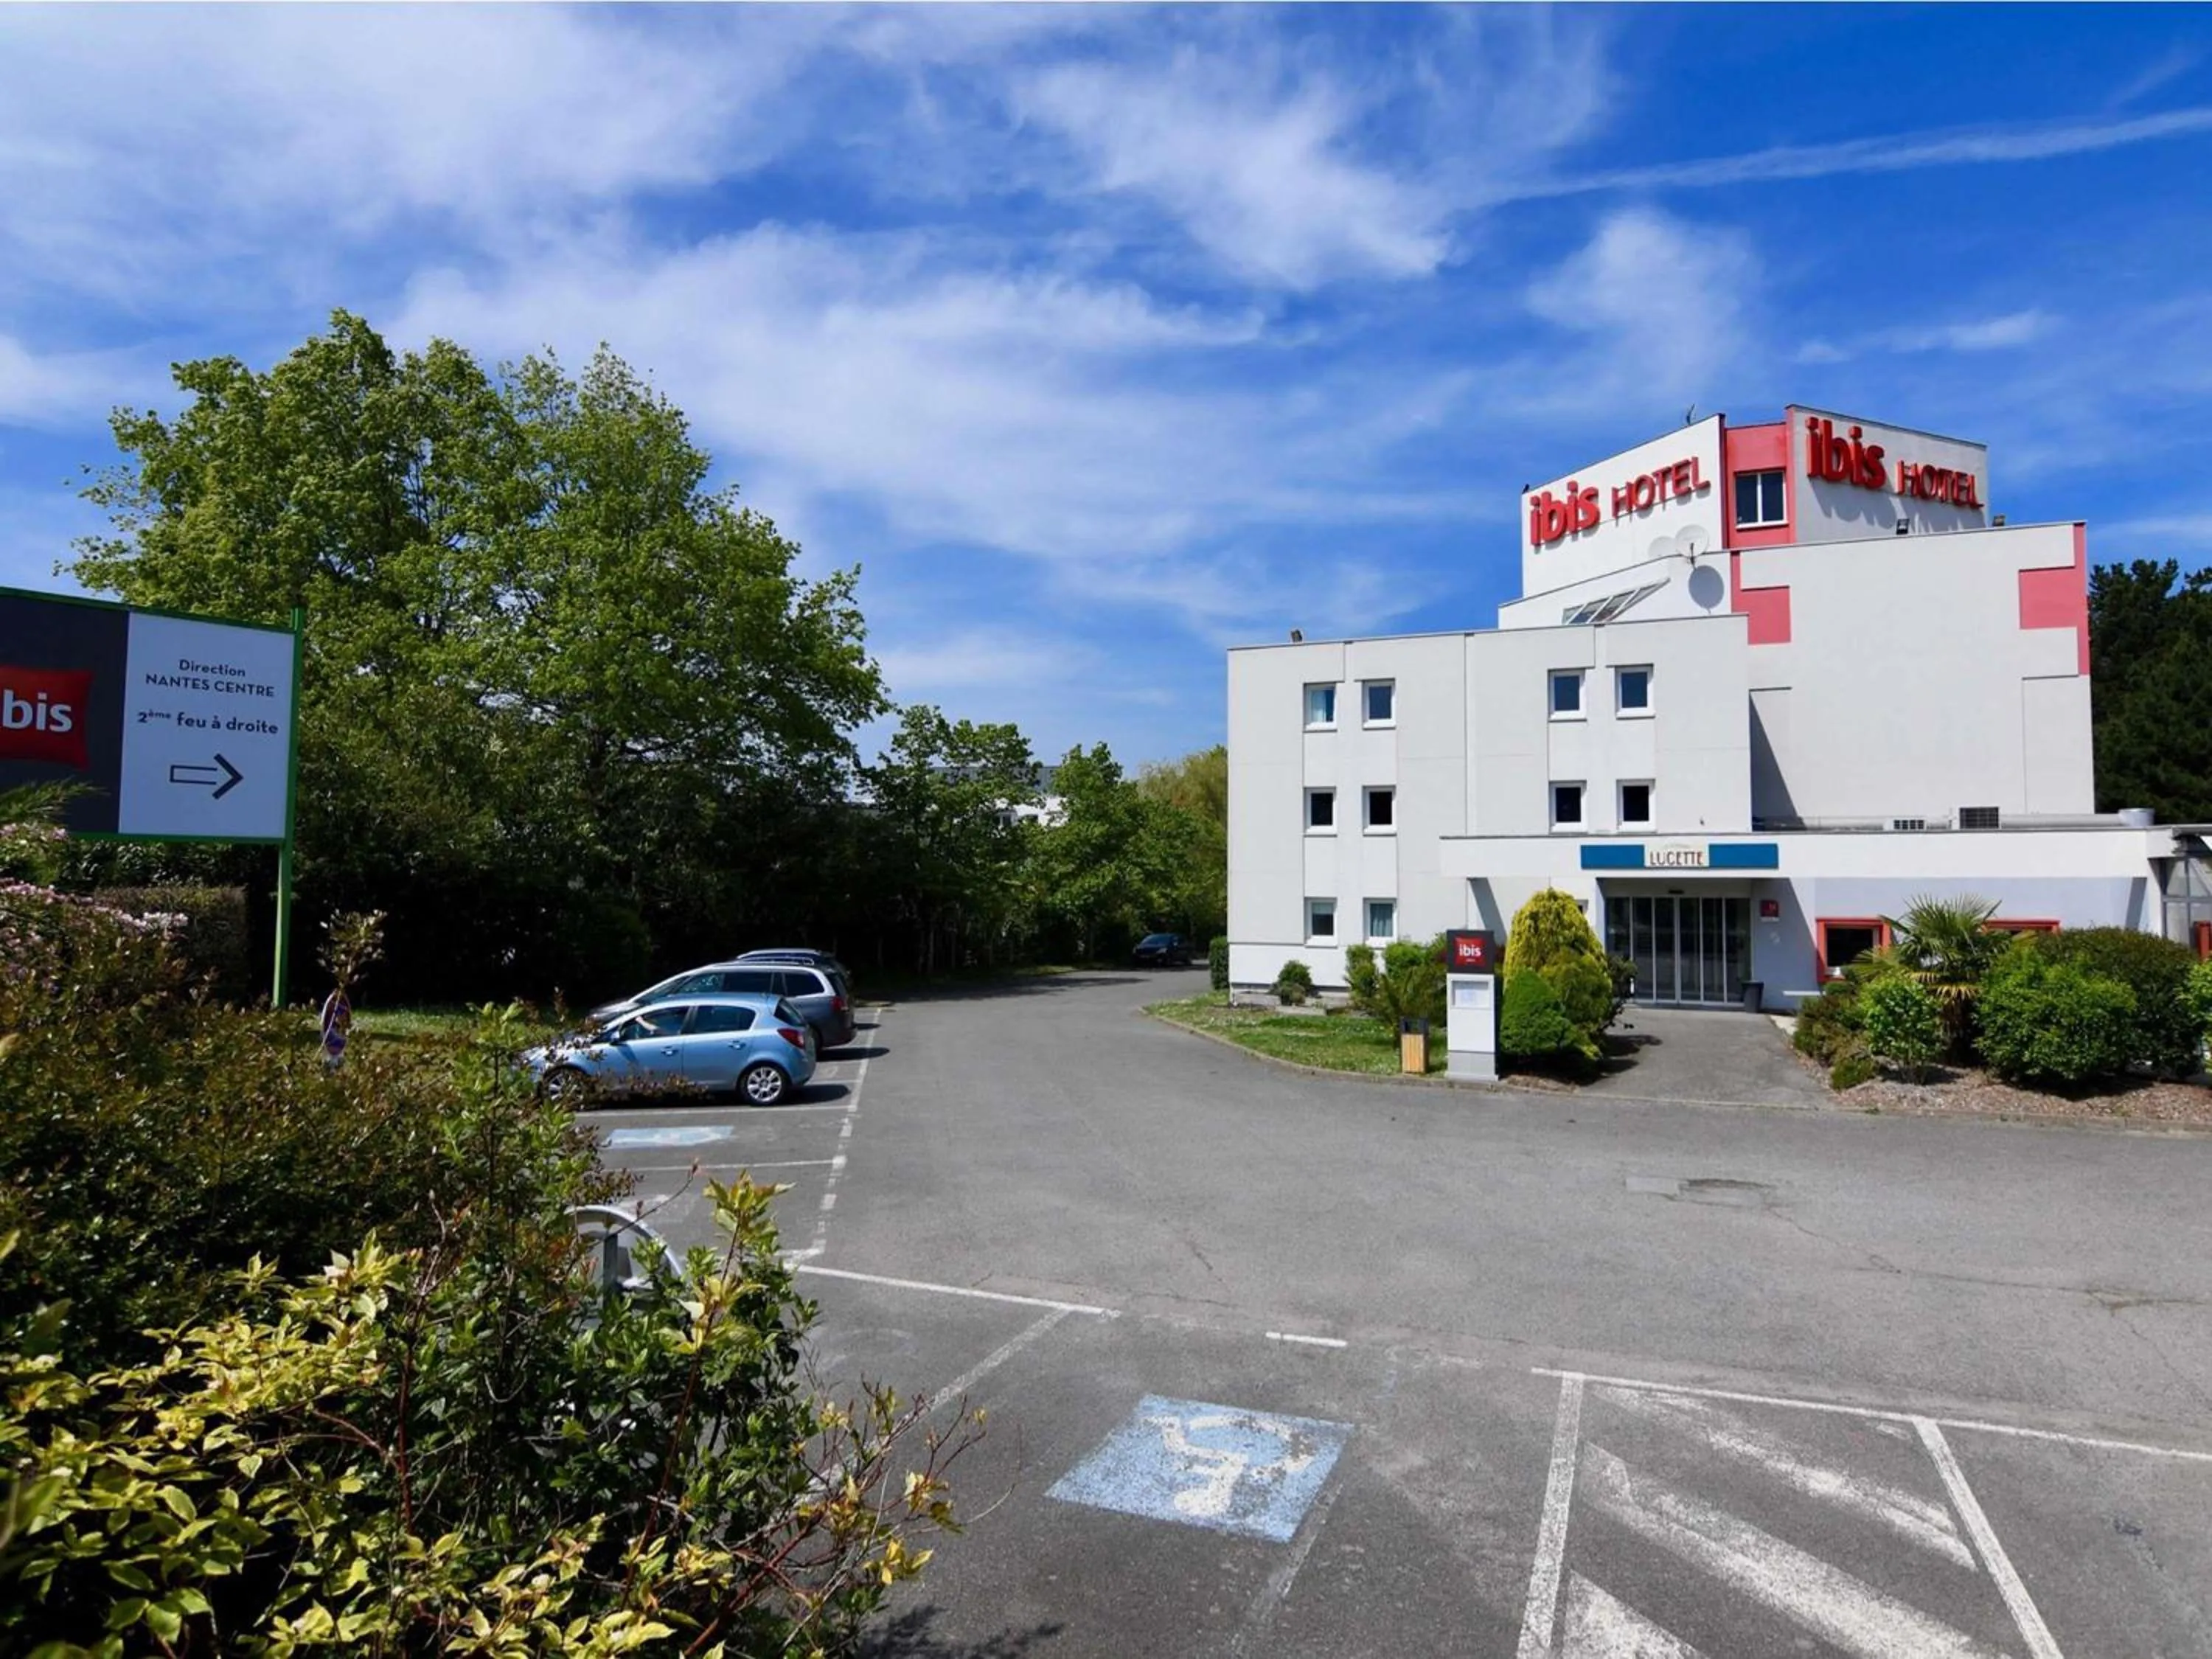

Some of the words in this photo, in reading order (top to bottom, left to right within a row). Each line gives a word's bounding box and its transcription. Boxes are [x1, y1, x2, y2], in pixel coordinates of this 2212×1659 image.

[1806, 417, 1886, 490] ibis
[1896, 460, 1983, 509] HOTEL
[1530, 481, 1599, 546] ibis
[1612, 456, 1711, 519] HOTEL
[179, 659, 246, 677] Direction
[146, 674, 210, 691] NANTES
[215, 681, 274, 697] CENTRE
[2, 689, 72, 732] bis
[138, 709, 172, 723] 2ème
[177, 712, 206, 728] feu
[212, 715, 220, 729] à
[226, 717, 279, 734] droite
[1650, 851, 1703, 865] LUCETTE
[1459, 944, 1481, 956] ibis
